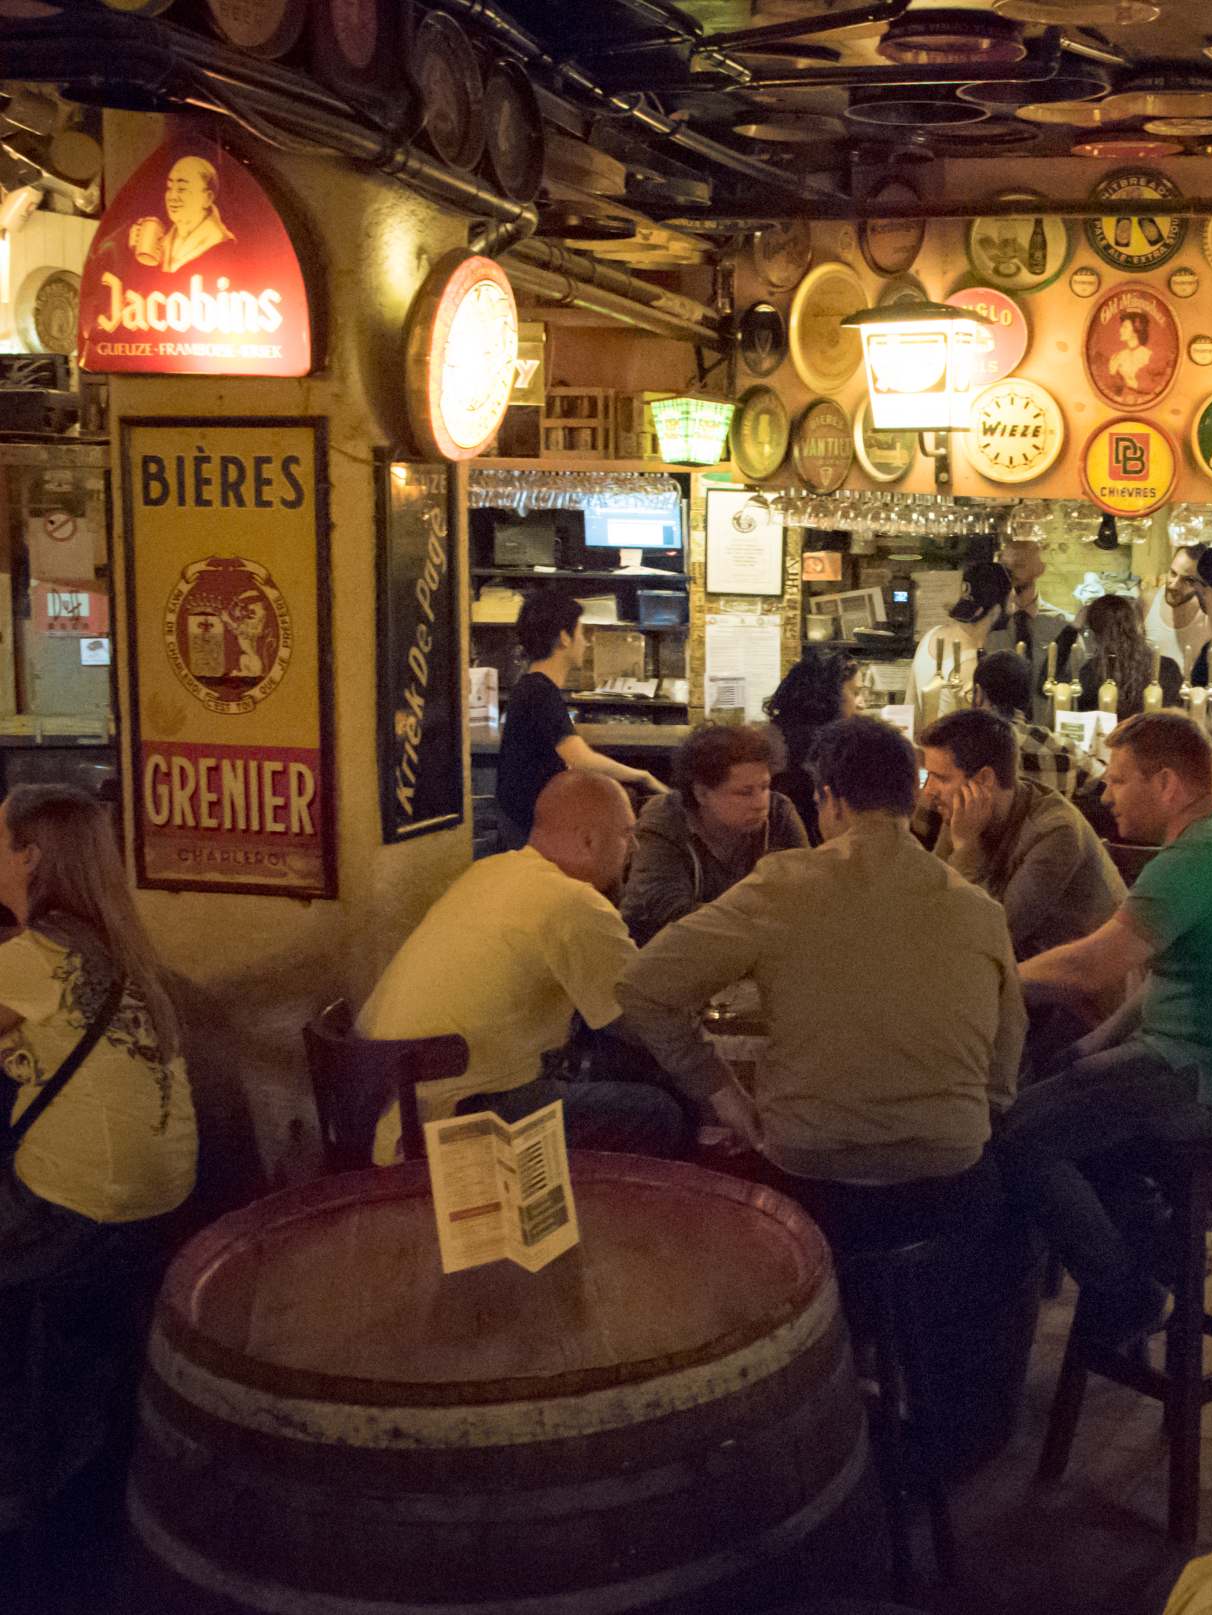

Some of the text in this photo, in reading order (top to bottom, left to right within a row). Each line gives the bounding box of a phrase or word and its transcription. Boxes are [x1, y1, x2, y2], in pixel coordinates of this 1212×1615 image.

[97, 271, 284, 334] Jacobins
[981, 420, 1042, 438] WIEZE
[141, 446, 305, 510] BIÈRES
[408, 623, 432, 687] De
[396, 683, 426, 817] Kriek
[144, 753, 316, 836] GRENIER
